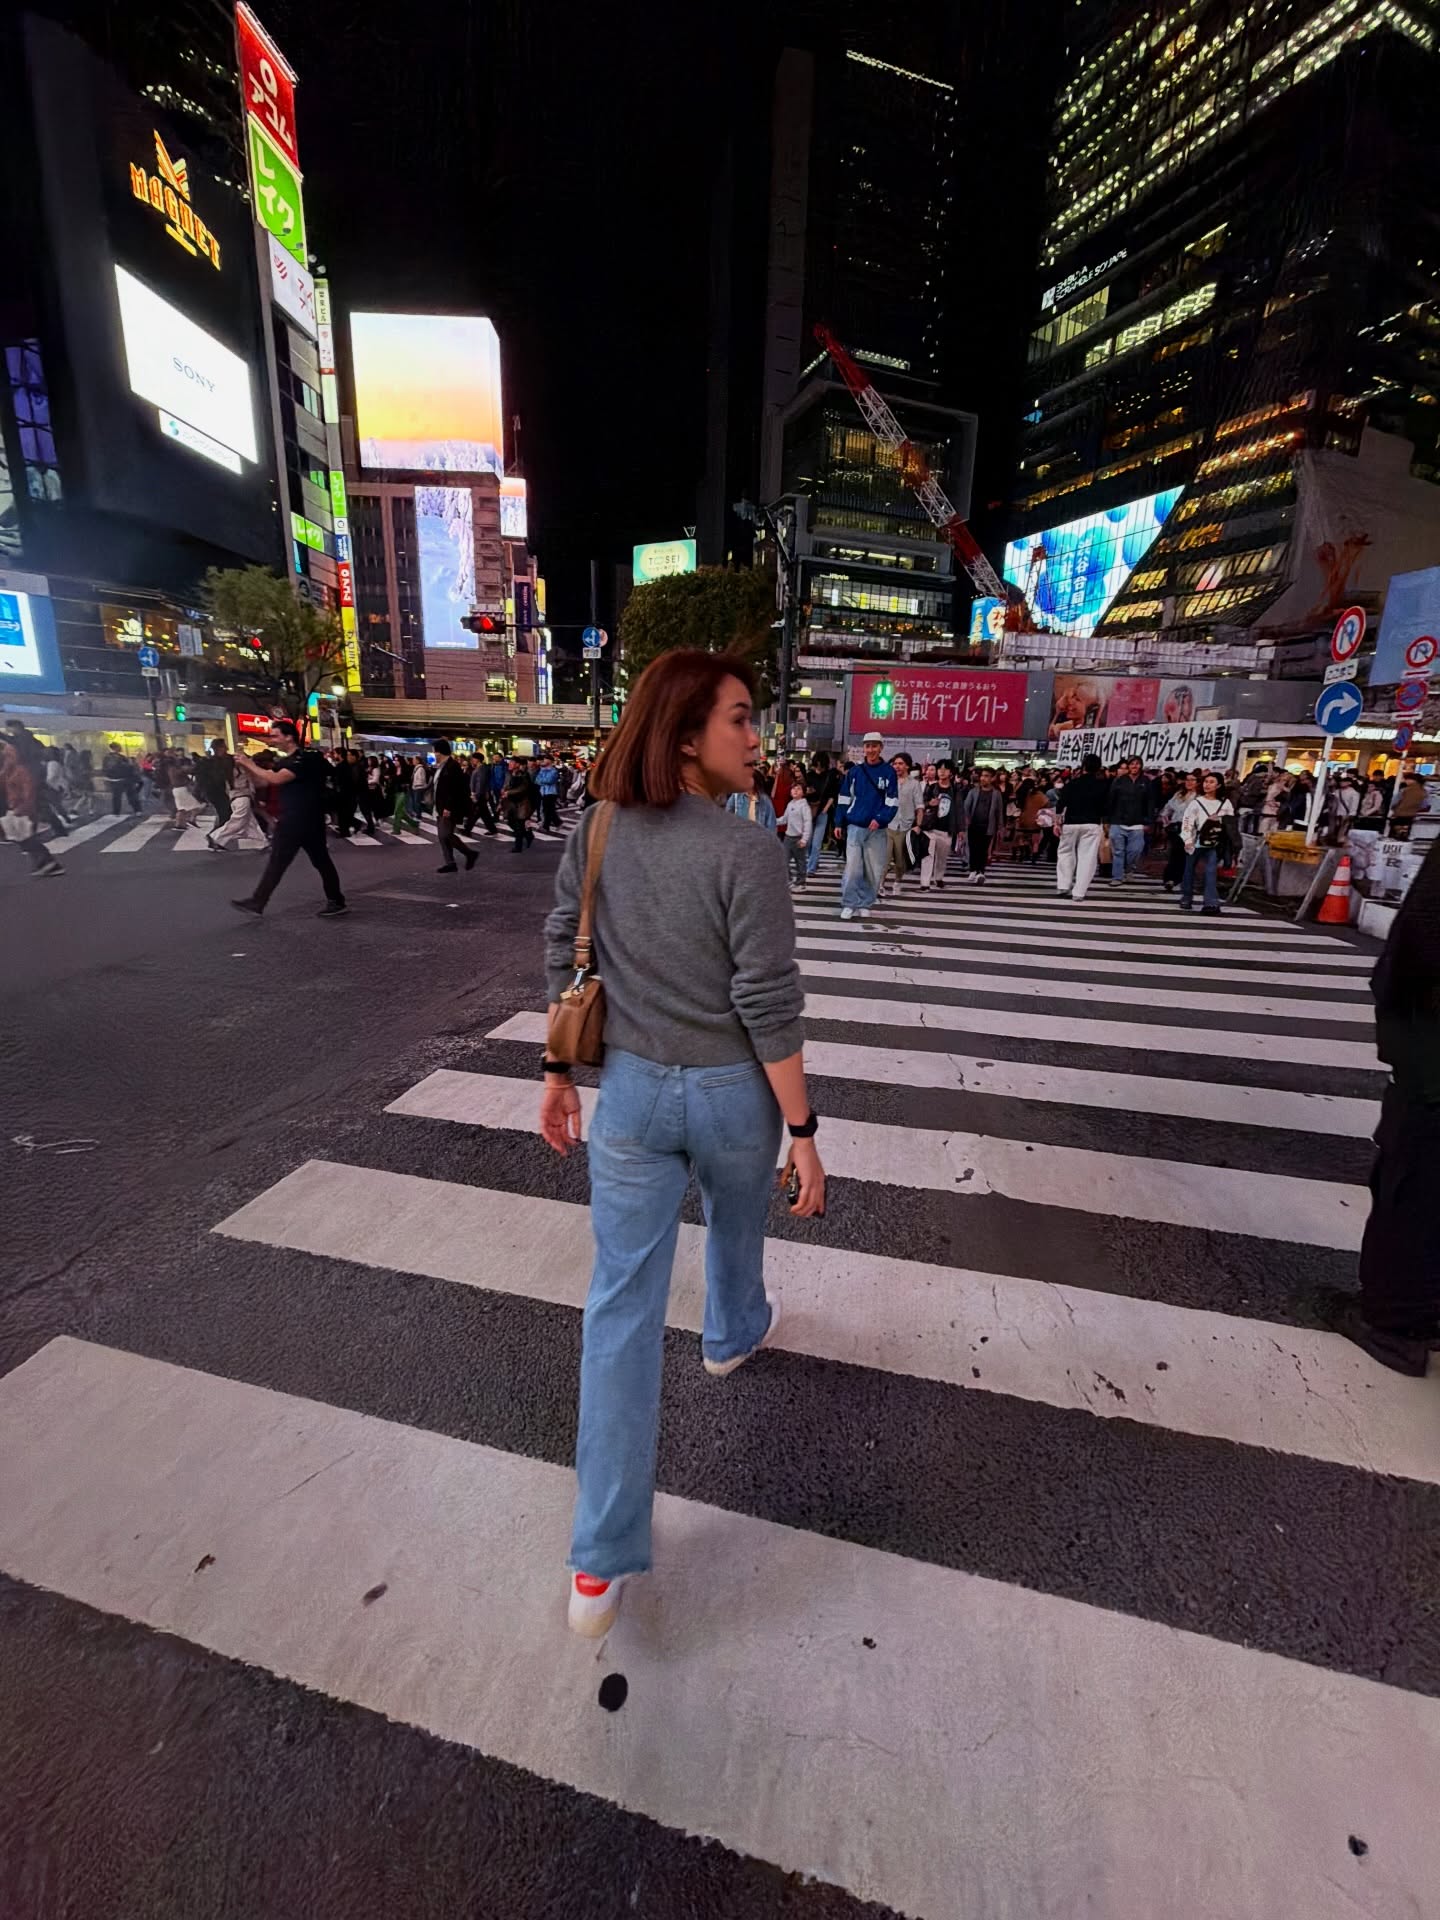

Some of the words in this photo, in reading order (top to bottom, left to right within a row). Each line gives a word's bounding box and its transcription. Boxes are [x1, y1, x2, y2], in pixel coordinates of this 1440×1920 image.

[129, 161, 221, 271] MAGNET
[172, 356, 216, 393] SONY
[514, 706, 528, 718] JR
